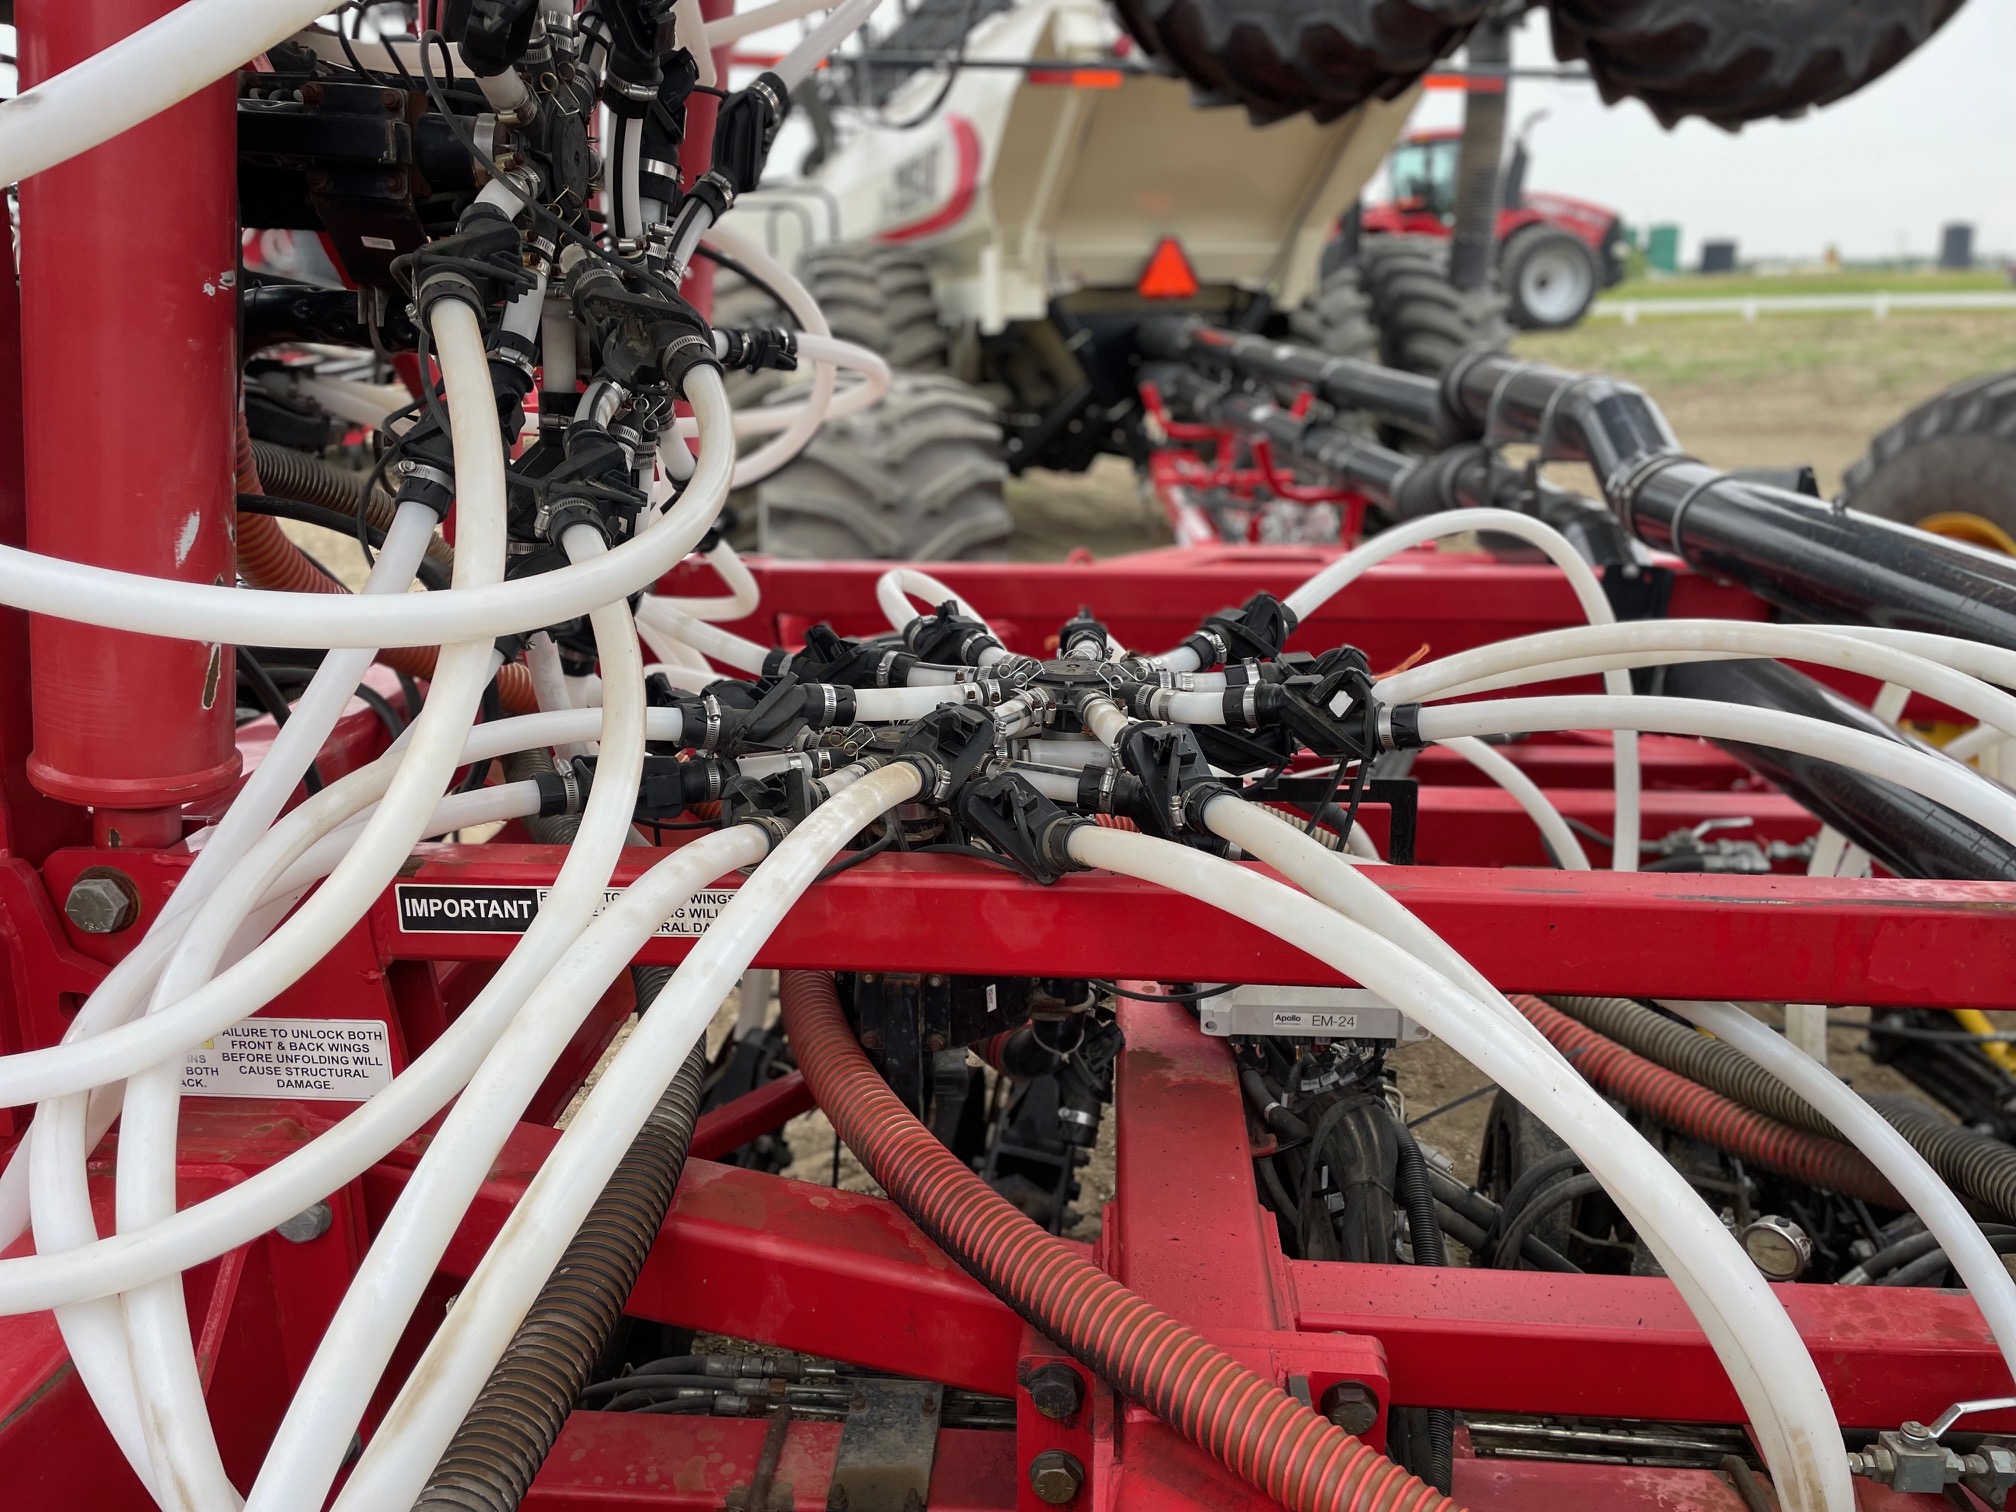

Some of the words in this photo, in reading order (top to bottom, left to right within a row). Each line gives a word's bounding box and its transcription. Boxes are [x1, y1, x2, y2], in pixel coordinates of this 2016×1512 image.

[404, 898, 532, 918] IMPORTANT
[1275, 1014, 1301, 1023] Apollo
[1312, 1014, 1355, 1028] EM-24
[222, 1028, 268, 1038] AILURE
[270, 1029, 288, 1038] TO
[291, 1029, 344, 1040] UNLOCK
[348, 1031, 382, 1041] BOTH
[231, 1040, 273, 1050] FRONT
[277, 1041, 286, 1051] &
[289, 1042, 325, 1052] BACK
[328, 1043, 370, 1053] WINGS
[222, 1053, 273, 1063] BEFORE
[276, 1054, 349, 1065] UNFOLDING
[352, 1056, 383, 1066] WILL
[185, 1066, 219, 1076] BOTH
[239, 1066, 282, 1076] CAUSE
[285, 1067, 369, 1079] STRUCTURAL
[181, 1078, 208, 1088] ACK.
[276, 1079, 335, 1090] DAMAGE.
